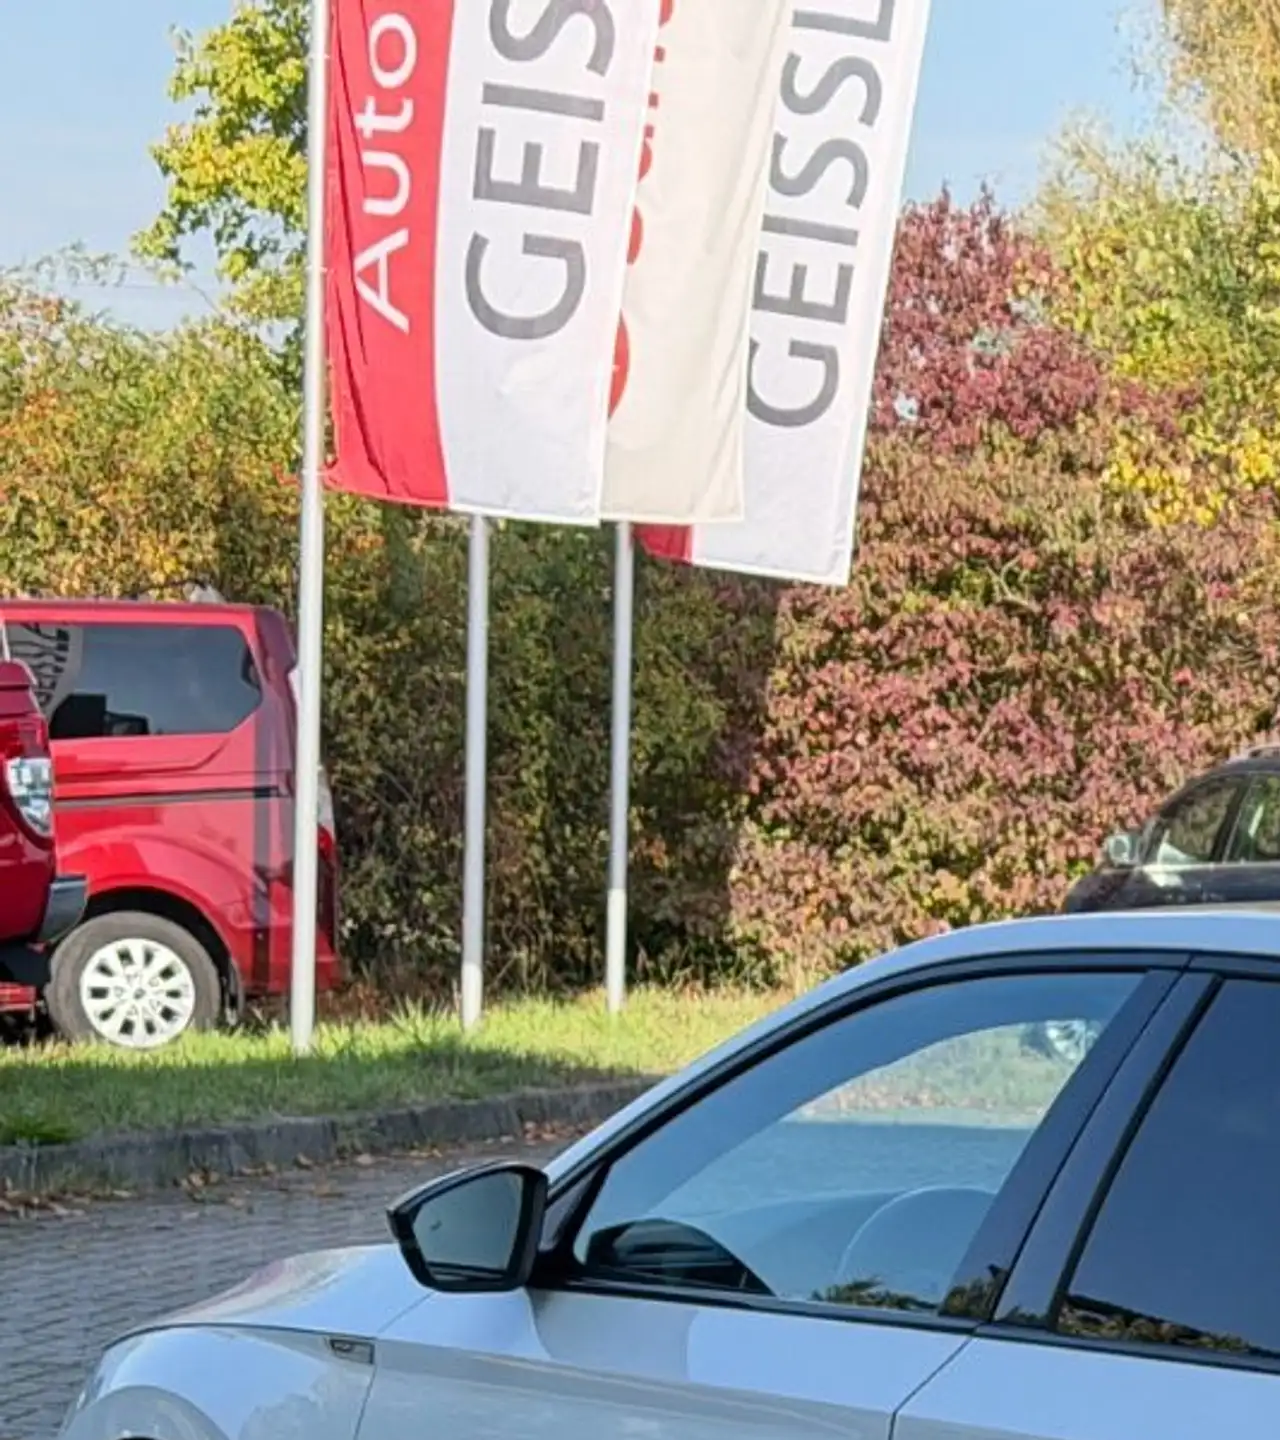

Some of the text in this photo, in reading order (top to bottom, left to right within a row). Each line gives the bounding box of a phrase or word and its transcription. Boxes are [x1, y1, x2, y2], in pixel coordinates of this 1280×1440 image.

[353, 12, 418, 335] Auto
[465, 0, 616, 340] GEIS
[745, 0, 896, 428] GEISSL
